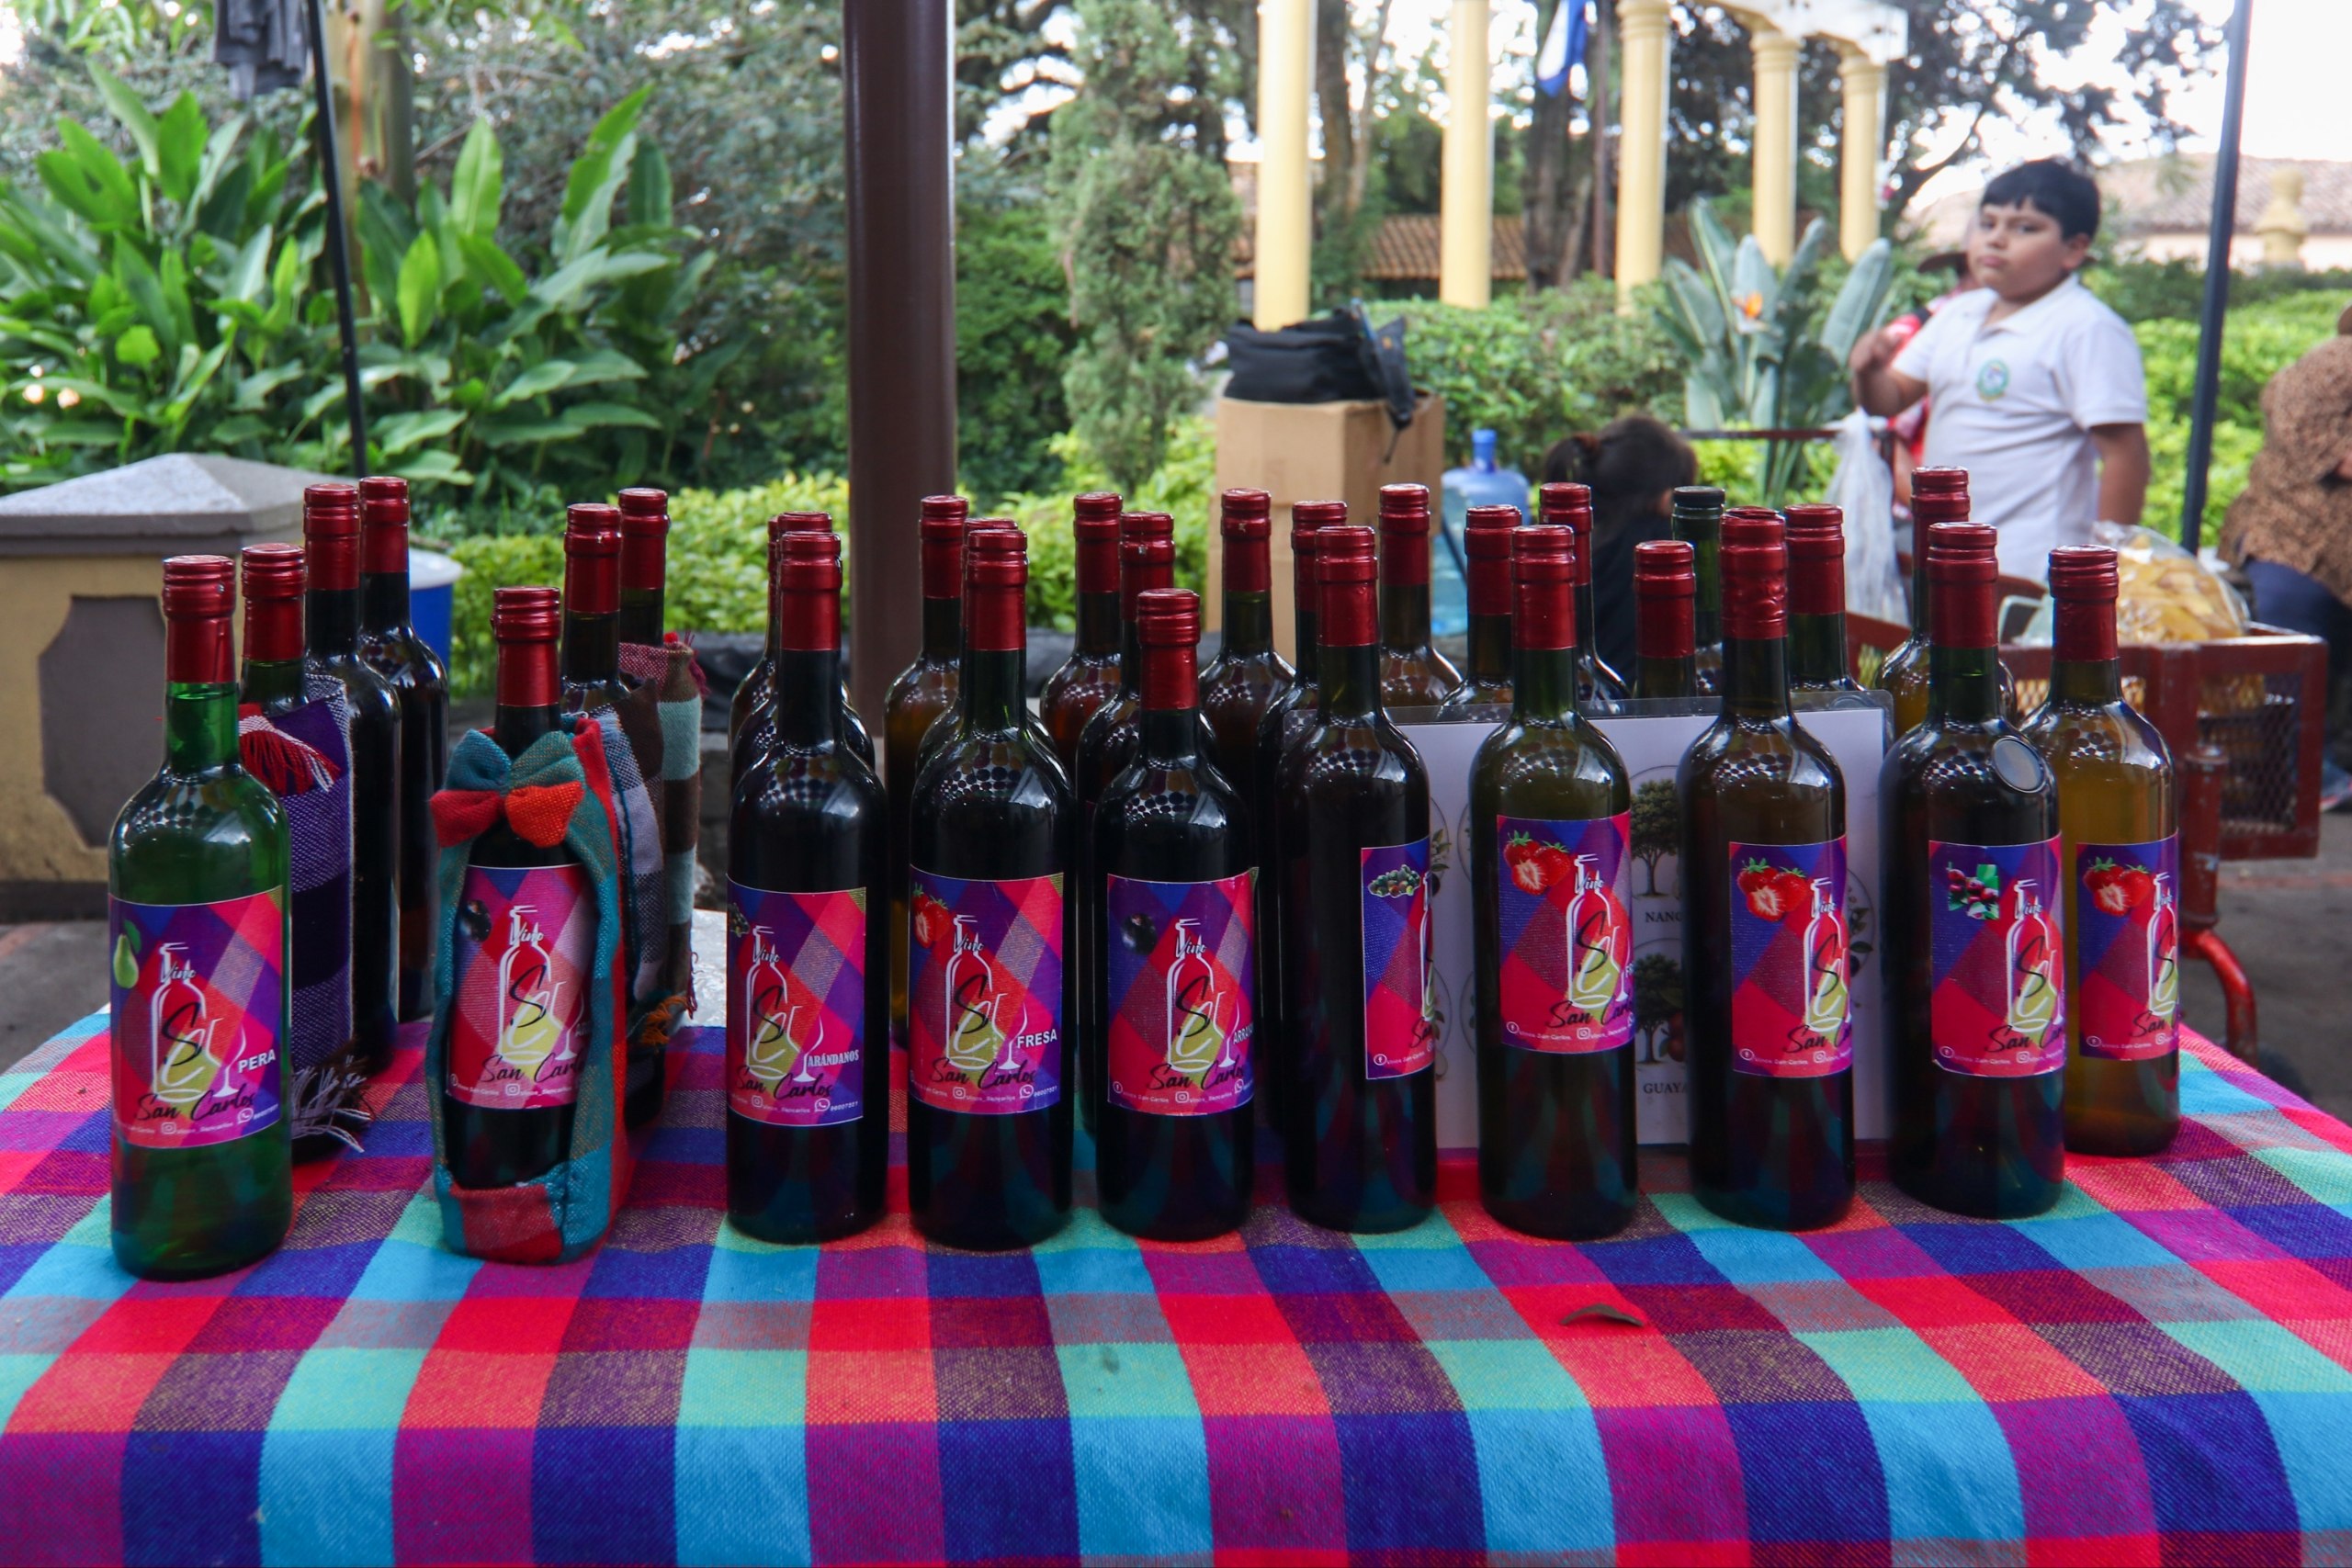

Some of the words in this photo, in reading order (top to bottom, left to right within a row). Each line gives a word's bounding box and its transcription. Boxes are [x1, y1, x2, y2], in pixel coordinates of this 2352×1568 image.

[1544, 999, 1593, 1030] San
[2128, 1010, 2166, 1038] San
[1016, 1028, 1057, 1049] FRESA
[1782, 1024, 1828, 1054] San
[1984, 1024, 2031, 1054] San
[237, 1049, 277, 1074] PERA
[480, 1054, 524, 1083] San
[808, 1049, 860, 1067] ARÁNDANOS
[773, 1072, 833, 1100] Carlos
[928, 1056, 970, 1084] San
[977, 1058, 1038, 1090] Carlos
[1147, 1062, 1193, 1090] San
[133, 1092, 181, 1122] San
[189, 1083, 255, 1122] Carlos
